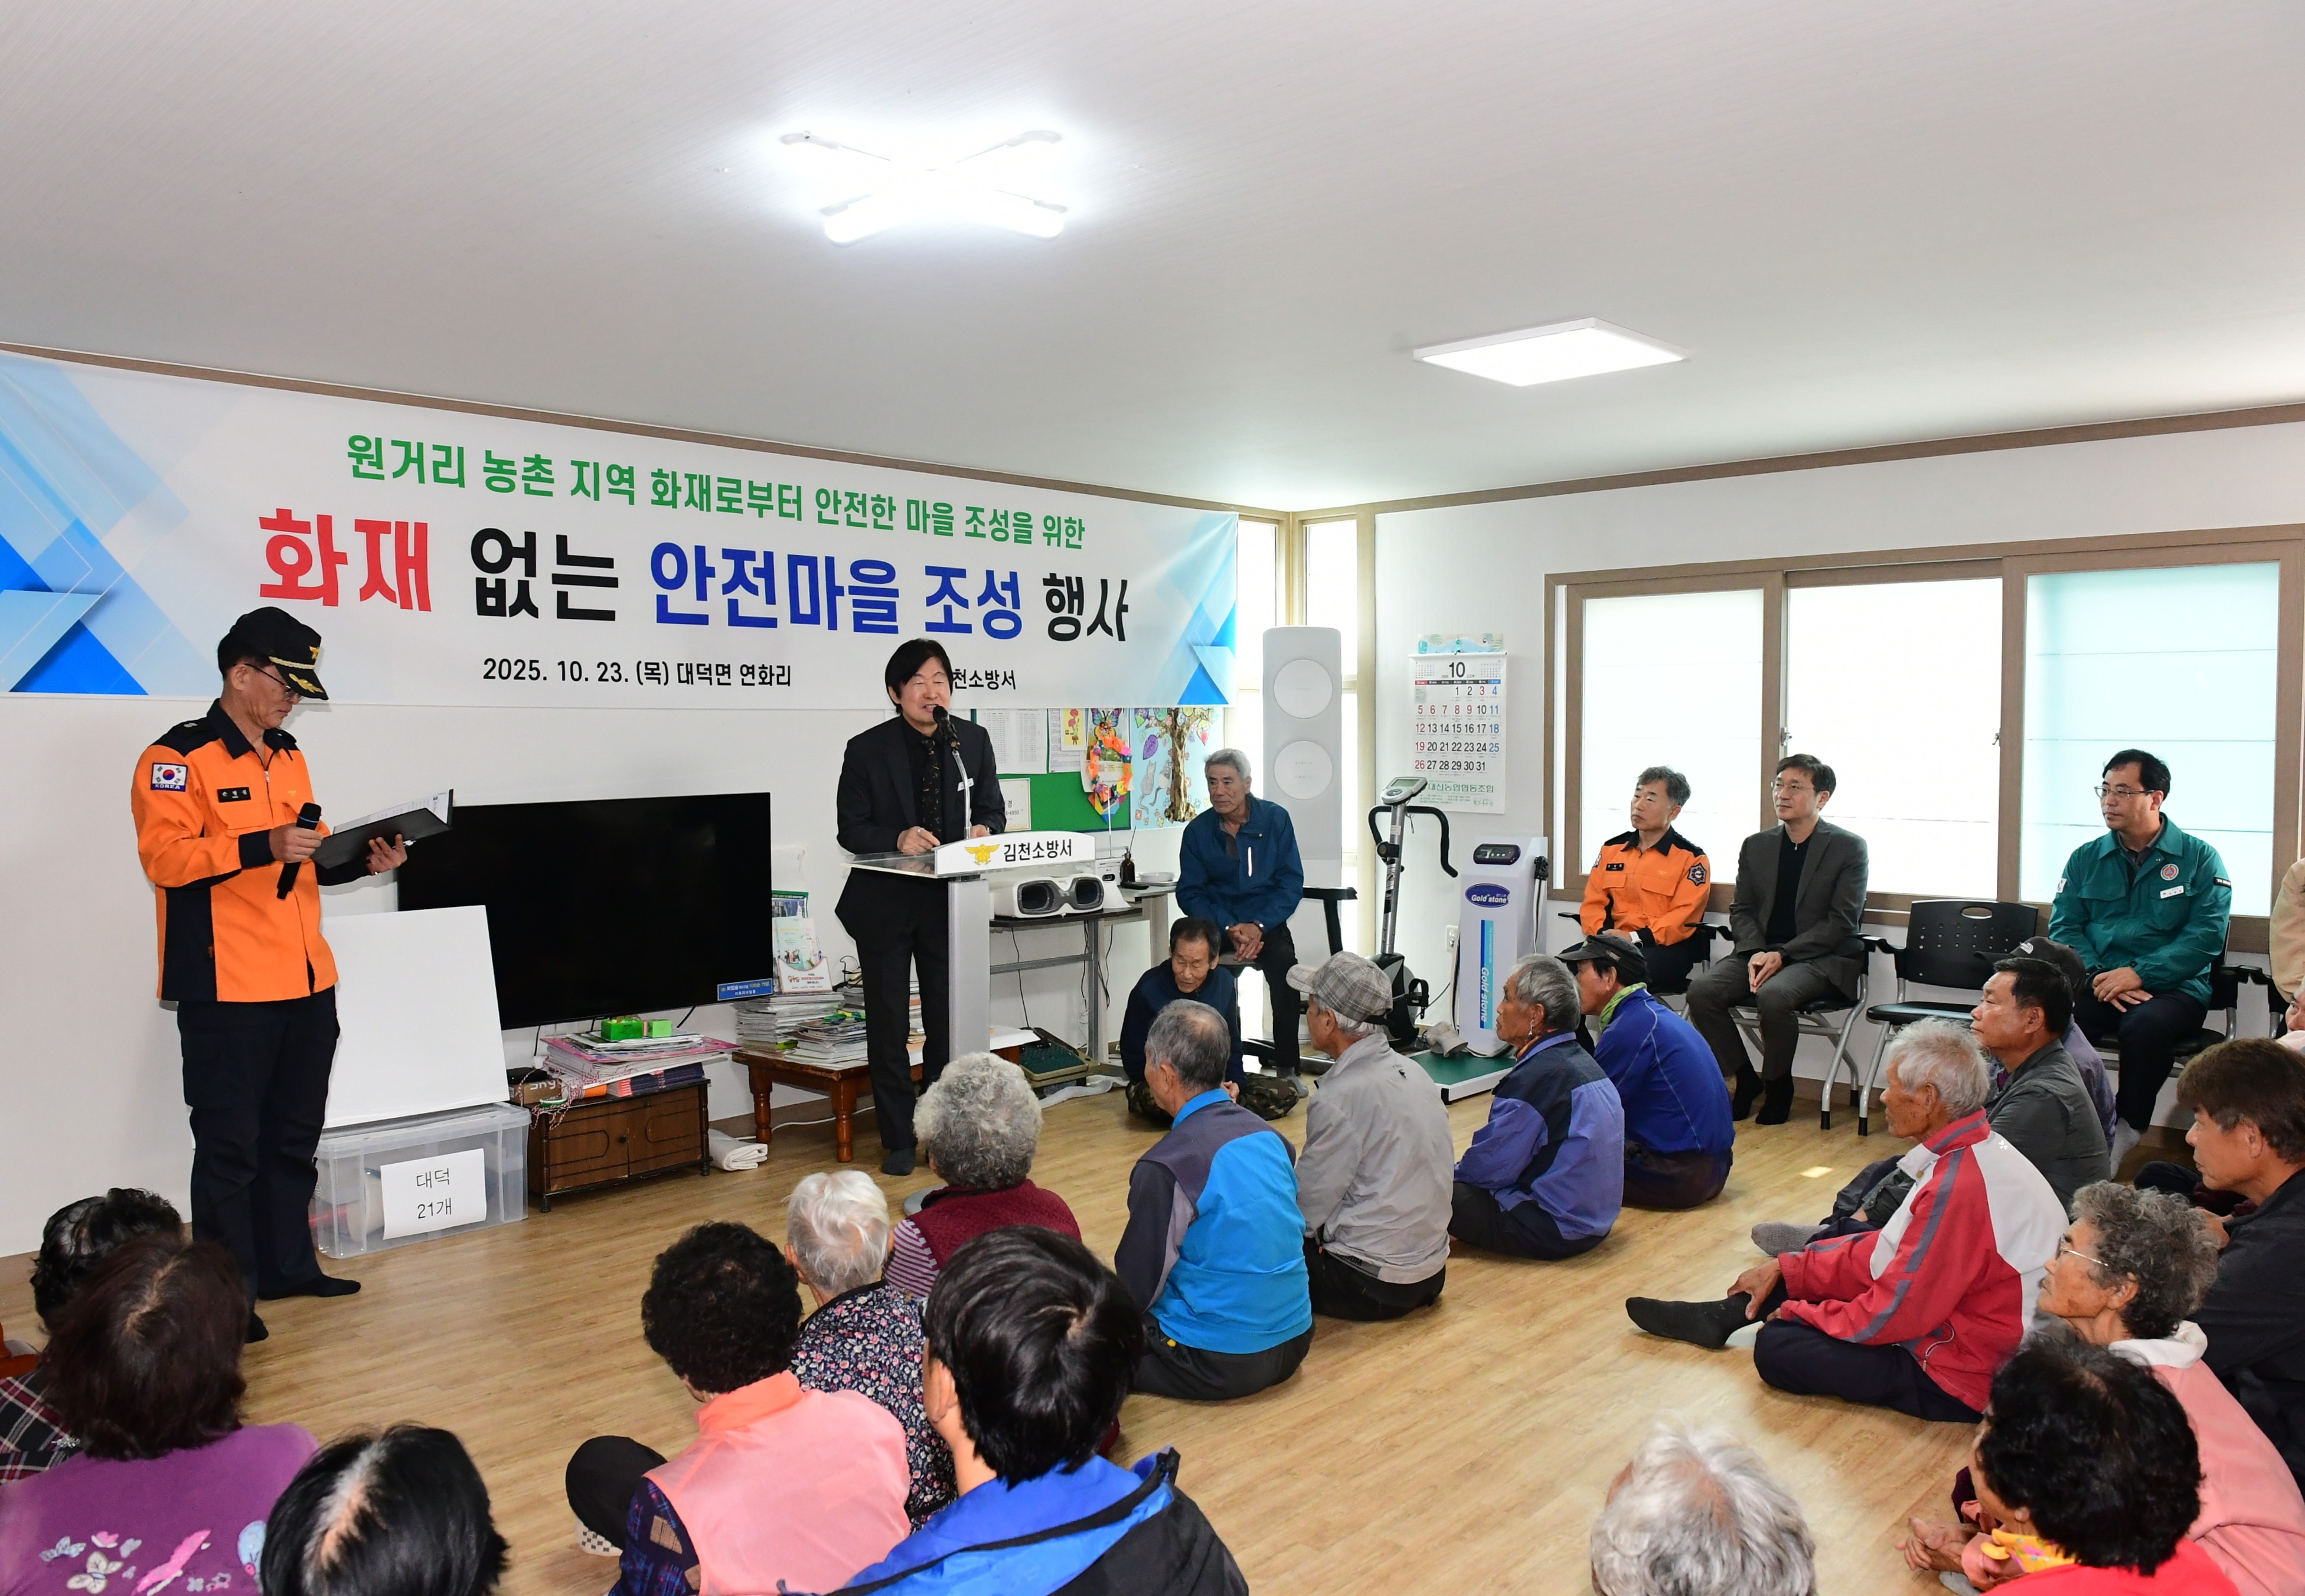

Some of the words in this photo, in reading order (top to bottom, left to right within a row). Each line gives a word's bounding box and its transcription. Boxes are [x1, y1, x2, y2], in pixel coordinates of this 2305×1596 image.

[348, 435, 466, 488] 원거리
[484, 450, 555, 497] 농촌
[571, 460, 635, 505] 지역
[651, 468, 803, 520] 화재로부터
[815, 488, 897, 531] 안전한
[907, 499, 954, 537] 마을
[965, 506, 1033, 544] 조성을
[1043, 515, 1085, 549] 위한
[259, 508, 432, 612] 화재
[471, 528, 618, 621] 없는
[651, 543, 900, 634] 안전마을
[925, 566, 1022, 639] 조성
[1043, 573, 1128, 641] 행사
[483, 658, 547, 680] 2025.
[558, 661, 589, 682] 10.
[597, 662, 629, 683] 23.
[636, 661, 669, 686] (목)
[677, 662, 732, 686] 대덕면
[740, 664, 791, 687] 연화리
[1449, 662, 1465, 677] 10
[1456, 687, 1458, 695] 1
[1468, 686, 1472, 695] 2
[1480, 686, 1484, 695] 3
[1493, 686, 1497, 695] 4
[1418, 706, 1422, 714] 5
[1431, 705, 1435, 714] 6
[1443, 706, 1447, 714] 7
[1455, 705, 1460, 714] 8
[1467, 705, 1472, 714] 9
[1477, 705, 1486, 714] 10
[1490, 705, 1498, 714] 11
[1416, 723, 1425, 732] 12
[1428, 723, 1436, 732] 13
[1441, 724, 1449, 732] 14
[1452, 724, 1461, 733] 15
[1465, 724, 1474, 733] 16
[1477, 724, 1485, 733] 17
[1490, 724, 1499, 733] 18
[1416, 742, 1424, 750] 19
[1428, 742, 1437, 751] 20
[1440, 742, 1448, 751] 21
[1452, 742, 1461, 751] 22
[1464, 743, 1474, 752] 23
[1477, 743, 1486, 752] 24
[1489, 743, 1499, 752] 25
[1415, 760, 1425, 769] 26
[1427, 761, 1436, 769] 27
[1439, 761, 1449, 770] 28
[1452, 761, 1461, 770] 29
[1464, 761, 1474, 771] 30
[1477, 762, 1484, 771] 31
[1004, 839, 1072, 862] 김천소방서
[1471, 894, 1487, 902] Gold
[416, 1167, 450, 1189] 대덕
[417, 1197, 452, 1219] 21개
